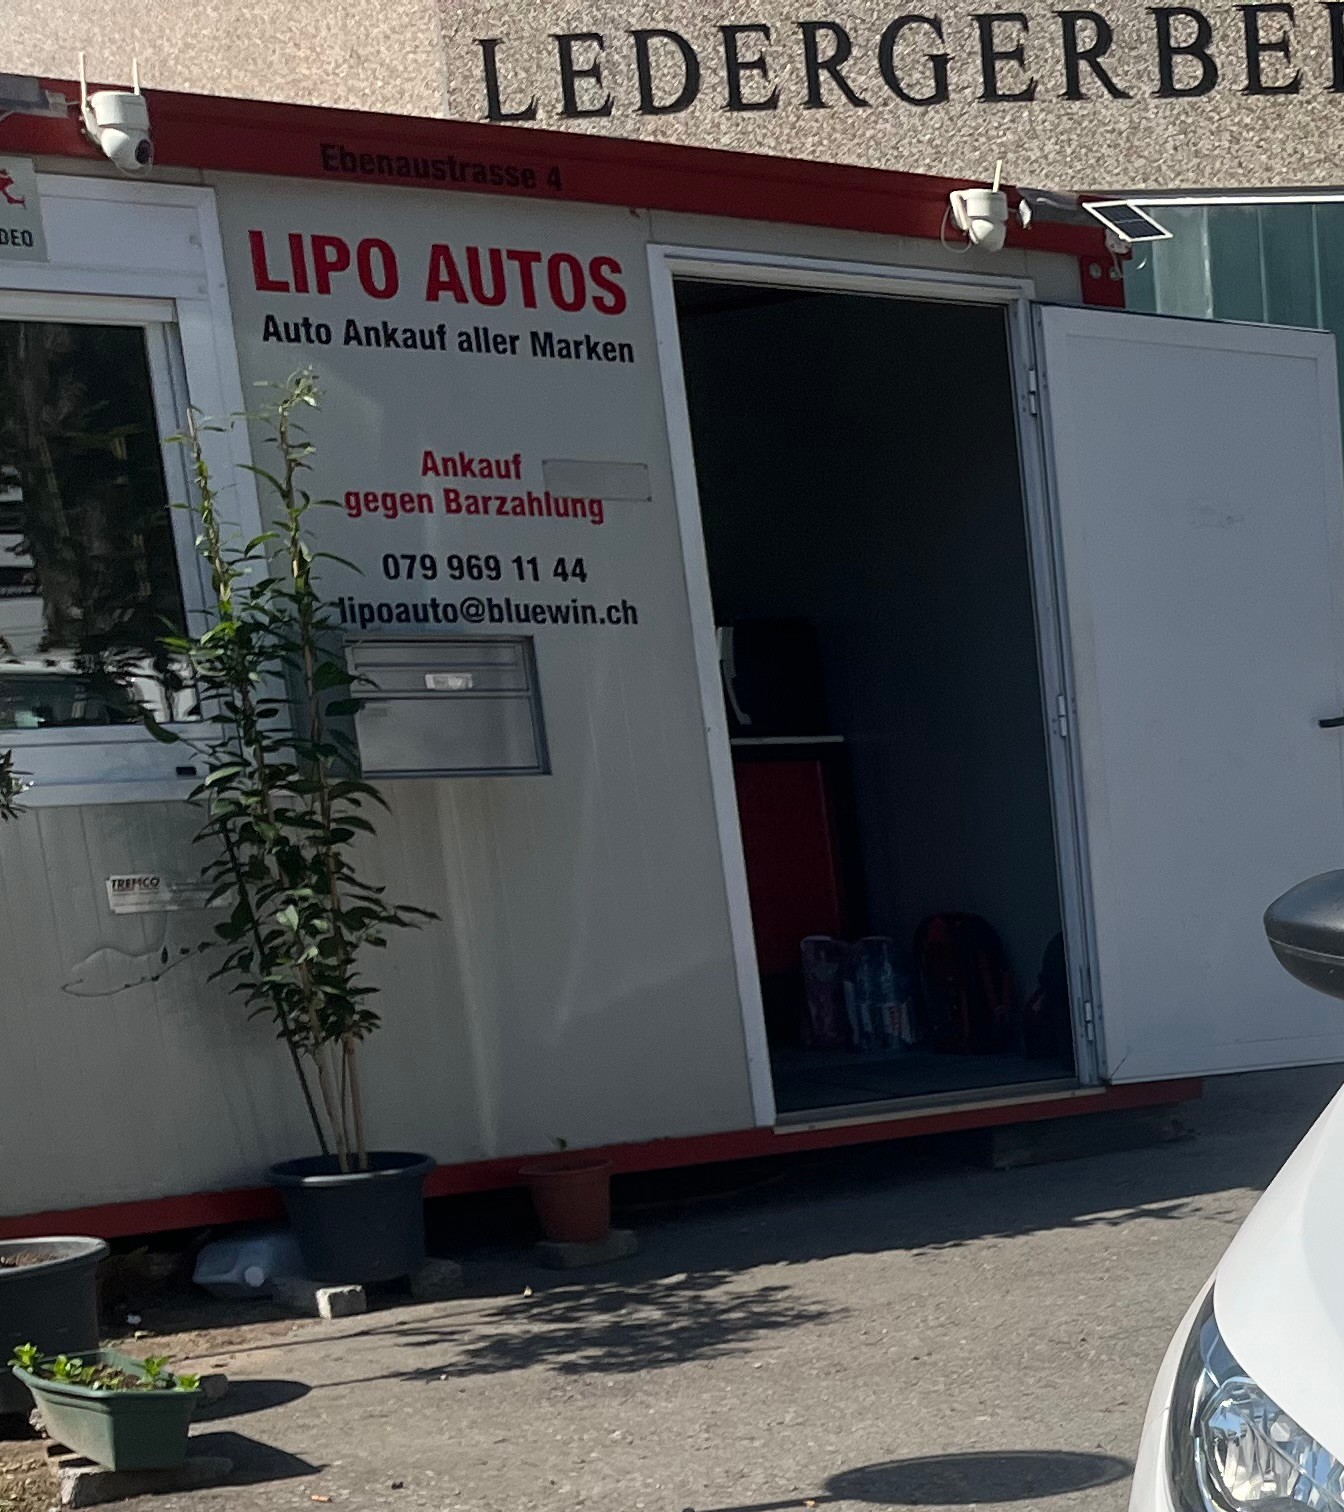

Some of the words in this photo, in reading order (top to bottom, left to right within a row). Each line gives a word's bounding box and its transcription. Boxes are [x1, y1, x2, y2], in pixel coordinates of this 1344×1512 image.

[320, 143, 537, 190] Ebenaustrasse
[546, 164, 564, 191] 4
[248, 230, 400, 299] LIPO
[425, 243, 627, 315] AUTOS
[263, 314, 333, 345] Auto
[343, 318, 448, 351] Ankauf
[457, 326, 520, 356] aller
[530, 330, 635, 363] Marken
[421, 450, 523, 480] Ankauf
[344, 490, 435, 519] gegen
[443, 488, 605, 525] Barzahlung
[382, 553, 437, 581] 079
[446, 554, 502, 581] 969
[512, 556, 541, 582] 11
[553, 557, 588, 583] 44
[338, 596, 639, 630] lipoauto@bluewin.ch
